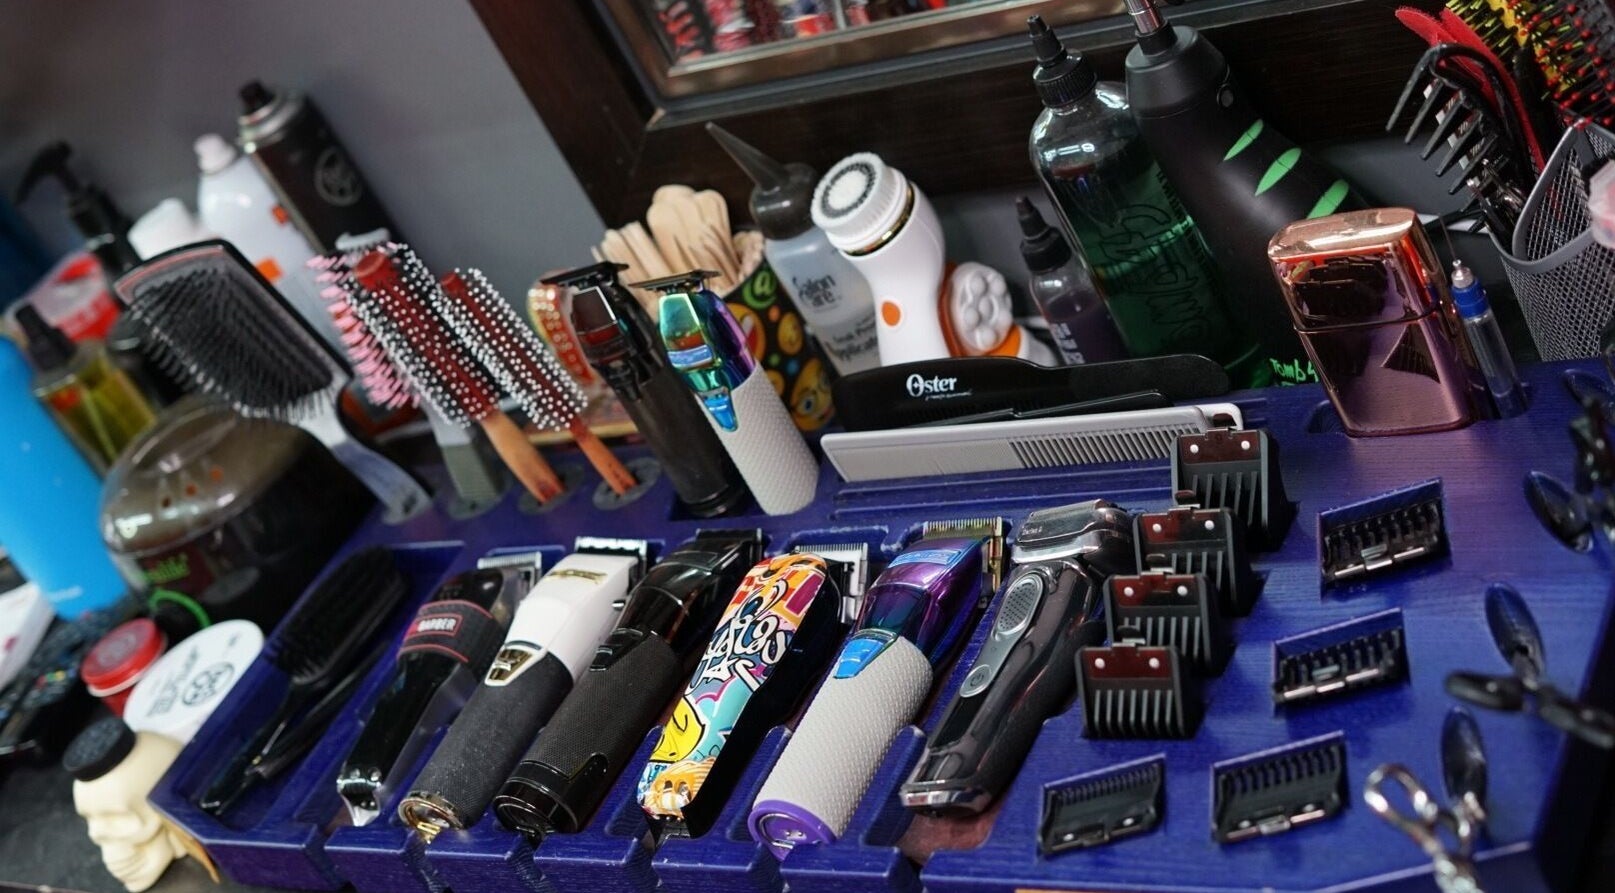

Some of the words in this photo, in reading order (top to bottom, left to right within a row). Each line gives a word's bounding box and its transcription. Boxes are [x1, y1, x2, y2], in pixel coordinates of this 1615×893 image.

[1270, 357, 1306, 383] Tomb
[906, 373, 958, 398] Oster
[417, 617, 457, 633] BARBER
